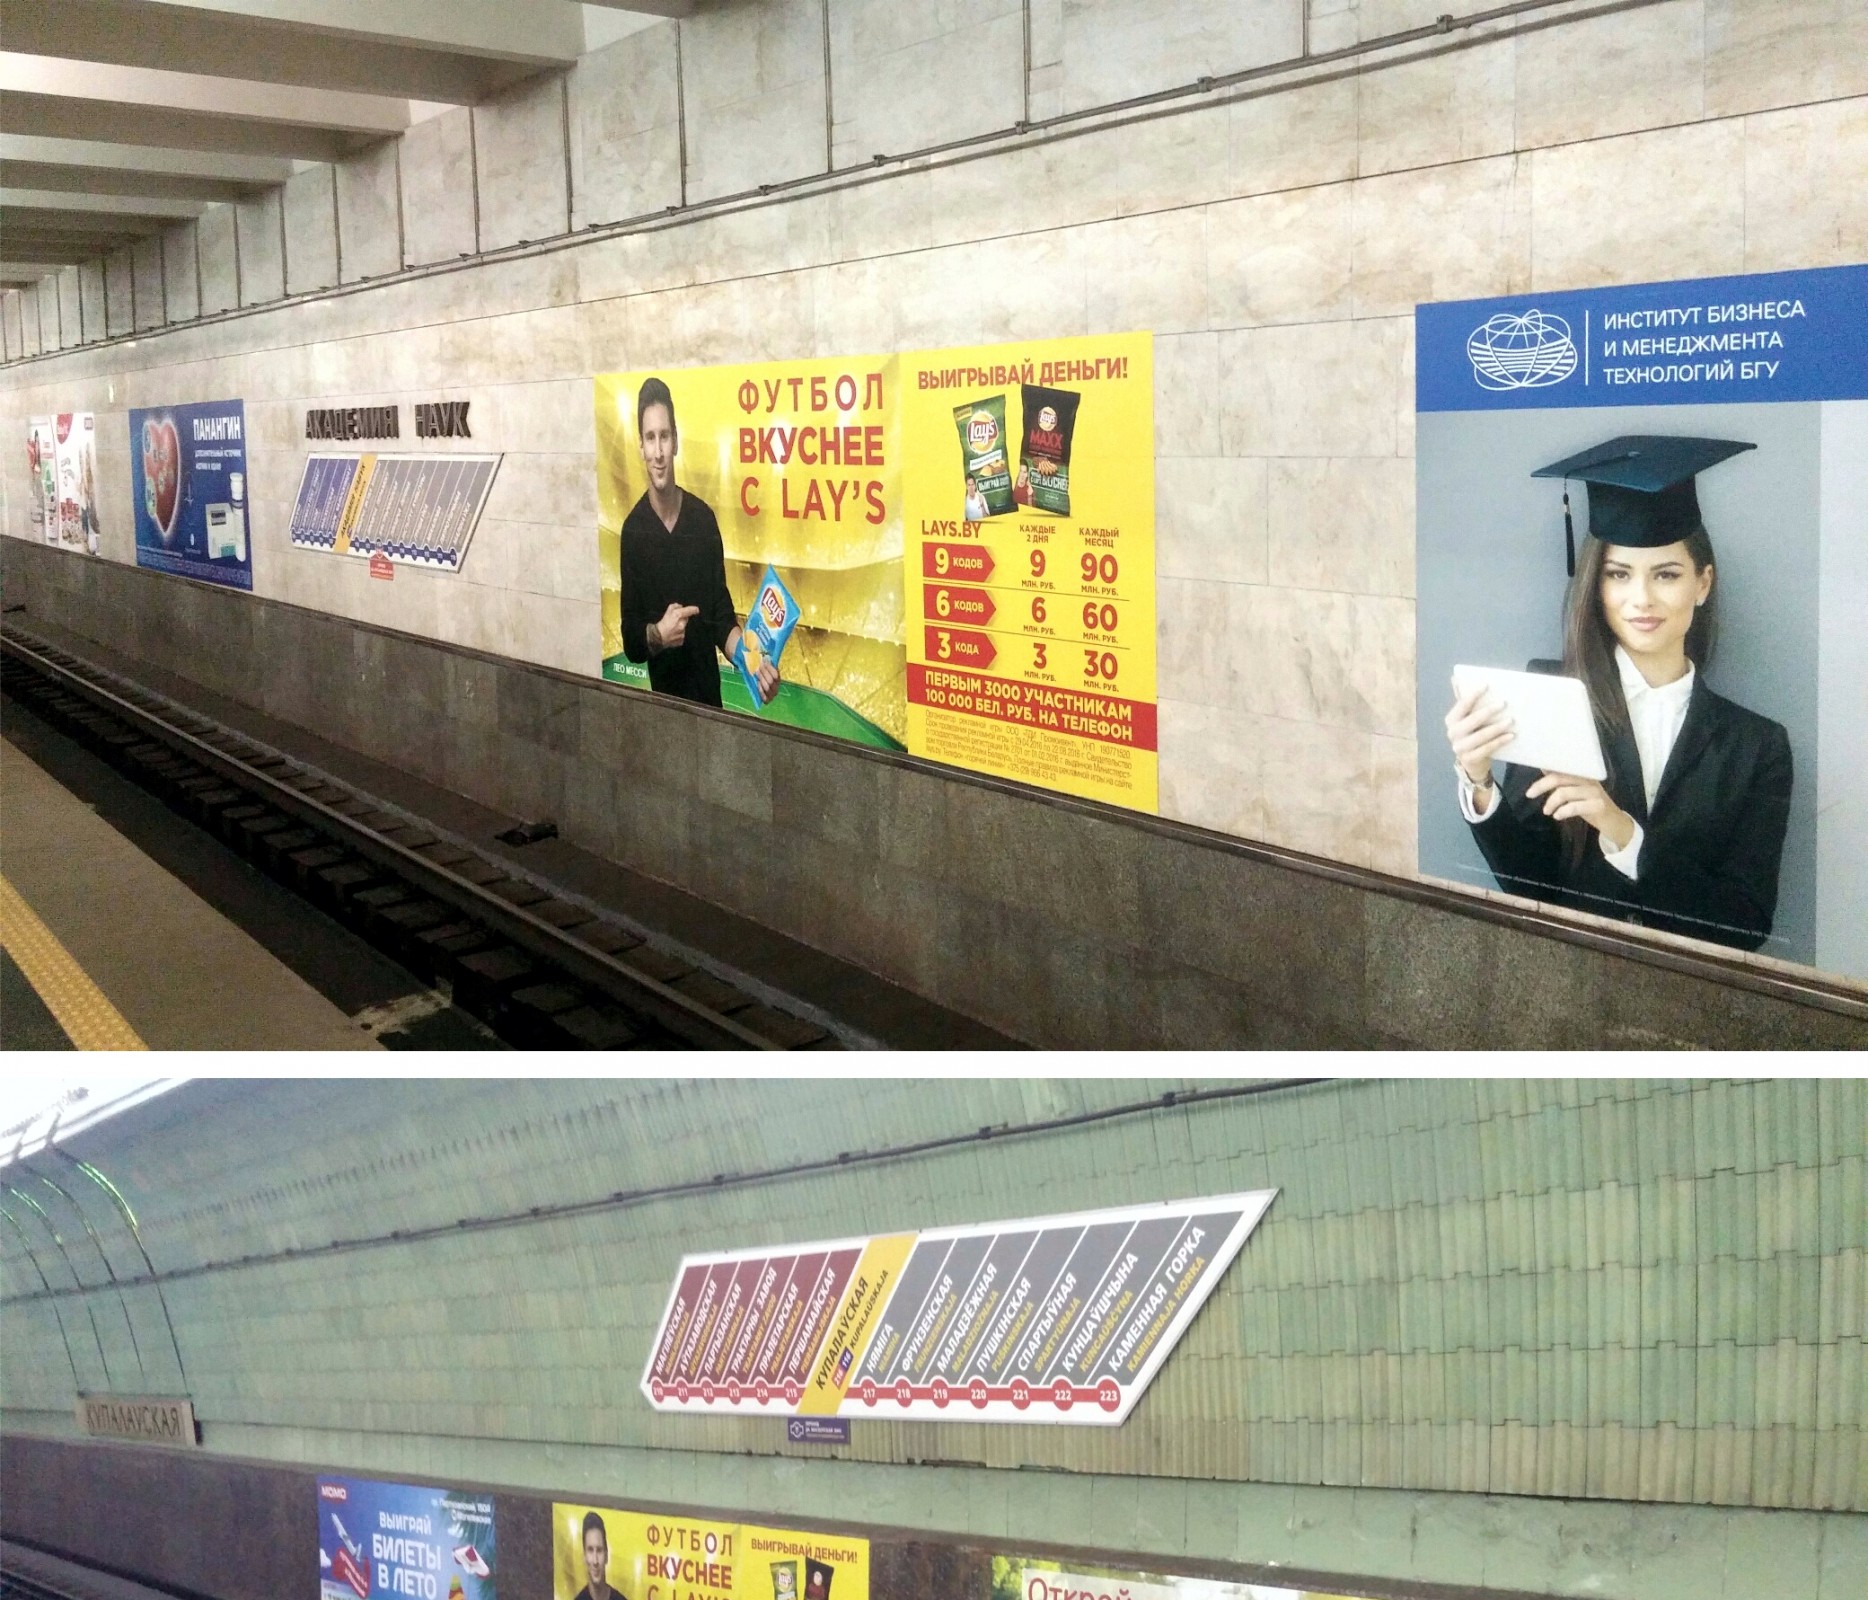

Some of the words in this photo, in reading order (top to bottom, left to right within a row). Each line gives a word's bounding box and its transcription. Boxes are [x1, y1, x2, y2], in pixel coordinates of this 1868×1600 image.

[1604, 308, 1702, 331] ИНСТИТУТ
[1707, 300, 1806, 323] БИЗНЕСА
[1604, 340, 1617, 357] И
[1622, 332, 1783, 357] МЕНЕДЖМЕНТА
[918, 358, 1034, 390] ВЫИГРЫВАЙ
[1039, 356, 1128, 386] ДЕНЬГИ!
[1603, 359, 1733, 385] ТЕХНОЛОГИЙ
[1740, 361, 1779, 383] БГУ
[738, 373, 884, 416] ФУТБОЛ
[193, 416, 241, 440] ПАНАНГИН
[305, 405, 400, 441] АКАДЕМИЯ
[414, 401, 472, 438] НАУК
[740, 426, 885, 467] ВКУСНЕЕ
[741, 477, 760, 517] С
[782, 476, 886, 526] LAY'S
[921, 519, 982, 539] LAYS.BY
[1019, 524, 1056, 534] КАЖДЫЕ
[1026, 534, 1032, 543] 2
[1033, 534, 1049, 544] ДНЯ
[1079, 527, 1120, 538] КАЖДЫЙ
[1084, 537, 1114, 549] МЕСЯЦ
[934, 547, 949, 575] 9
[952, 556, 983, 570] КОДОВ
[1030, 549, 1046, 578] 9
[1080, 552, 1118, 584] 90
[1021, 579, 1038, 589] МЛН.
[1039, 580, 1056, 591] РУБ.
[935, 590, 950, 617] 6
[954, 600, 984, 613] КОДОВ
[1031, 596, 1046, 623] 6
[1082, 601, 1118, 632] 60
[937, 632, 951, 659] 3
[955, 644, 980, 656] КОДА
[1033, 642, 1047, 670] 3
[613, 662, 625, 673] ЛЕО
[625, 665, 648, 679] МЕССИ
[1083, 649, 1118, 681] 30
[925, 670, 982, 694] ПЕРВЫМ
[985, 680, 1021, 702] 3000
[1023, 687, 1132, 722] УЧАСТНИКАМ
[925, 689, 946, 705] 100
[948, 693, 973, 709] 000
[975, 696, 1004, 716] БЕЛ.
[1006, 702, 1036, 722] РУБ.
[1039, 710, 1059, 727] НА
[1062, 713, 1133, 741] ТЕЛЕФОН
[757, 1265, 778, 1309] ЗАВОД
[1174, 1255, 1206, 1301] HORKA
[1061, 1252, 1139, 1373] КУНЦАЎШЧЫНА
[1108, 1282, 1168, 1373] КАМЕННАЯ
[1165, 1226, 1206, 1284] ГОРКА
[758, 1282, 799, 1375] ПРАЛЕТАРСКАЯ
[788, 1266, 836, 1375] ПЕРШАМАЙСКАЯ
[901, 1273, 954, 1372] ФРУНЗЕНСКАЯ
[936, 1262, 998, 1373] МАЛАДЗЁЖНАЯ
[976, 1276, 1032, 1373] ПУШКІНСКАЯ
[1017, 1271, 1078, 1372] СПАРТЫЎНАЯ
[815, 1276, 869, 1391] КУПАЛАЎСКАЯ
[866, 1323, 894, 1374] НЯМІГА
[862, 1388, 876, 1398] 217
[897, 1388, 911, 1399] 218
[933, 1388, 948, 1399] 219
[970, 1388, 987, 1399] 220
[1012, 1389, 1029, 1400] 221
[1054, 1389, 1072, 1401] 222
[1099, 1389, 1118, 1401] 223
[379, 1511, 432, 1535] ВЫИГРАЙ
[372, 1533, 441, 1571] БИЛЕТЫ
[646, 1523, 733, 1557] ФУТБОЛ
[751, 1538, 812, 1558] ВЫИГРЫВАЙ
[814, 1546, 858, 1564] ДЕНЬГИ!
[378, 1563, 389, 1589] В
[392, 1567, 437, 1600] ЛЕТО
[647, 1554, 733, 1589] ВКУСНЕЕ
